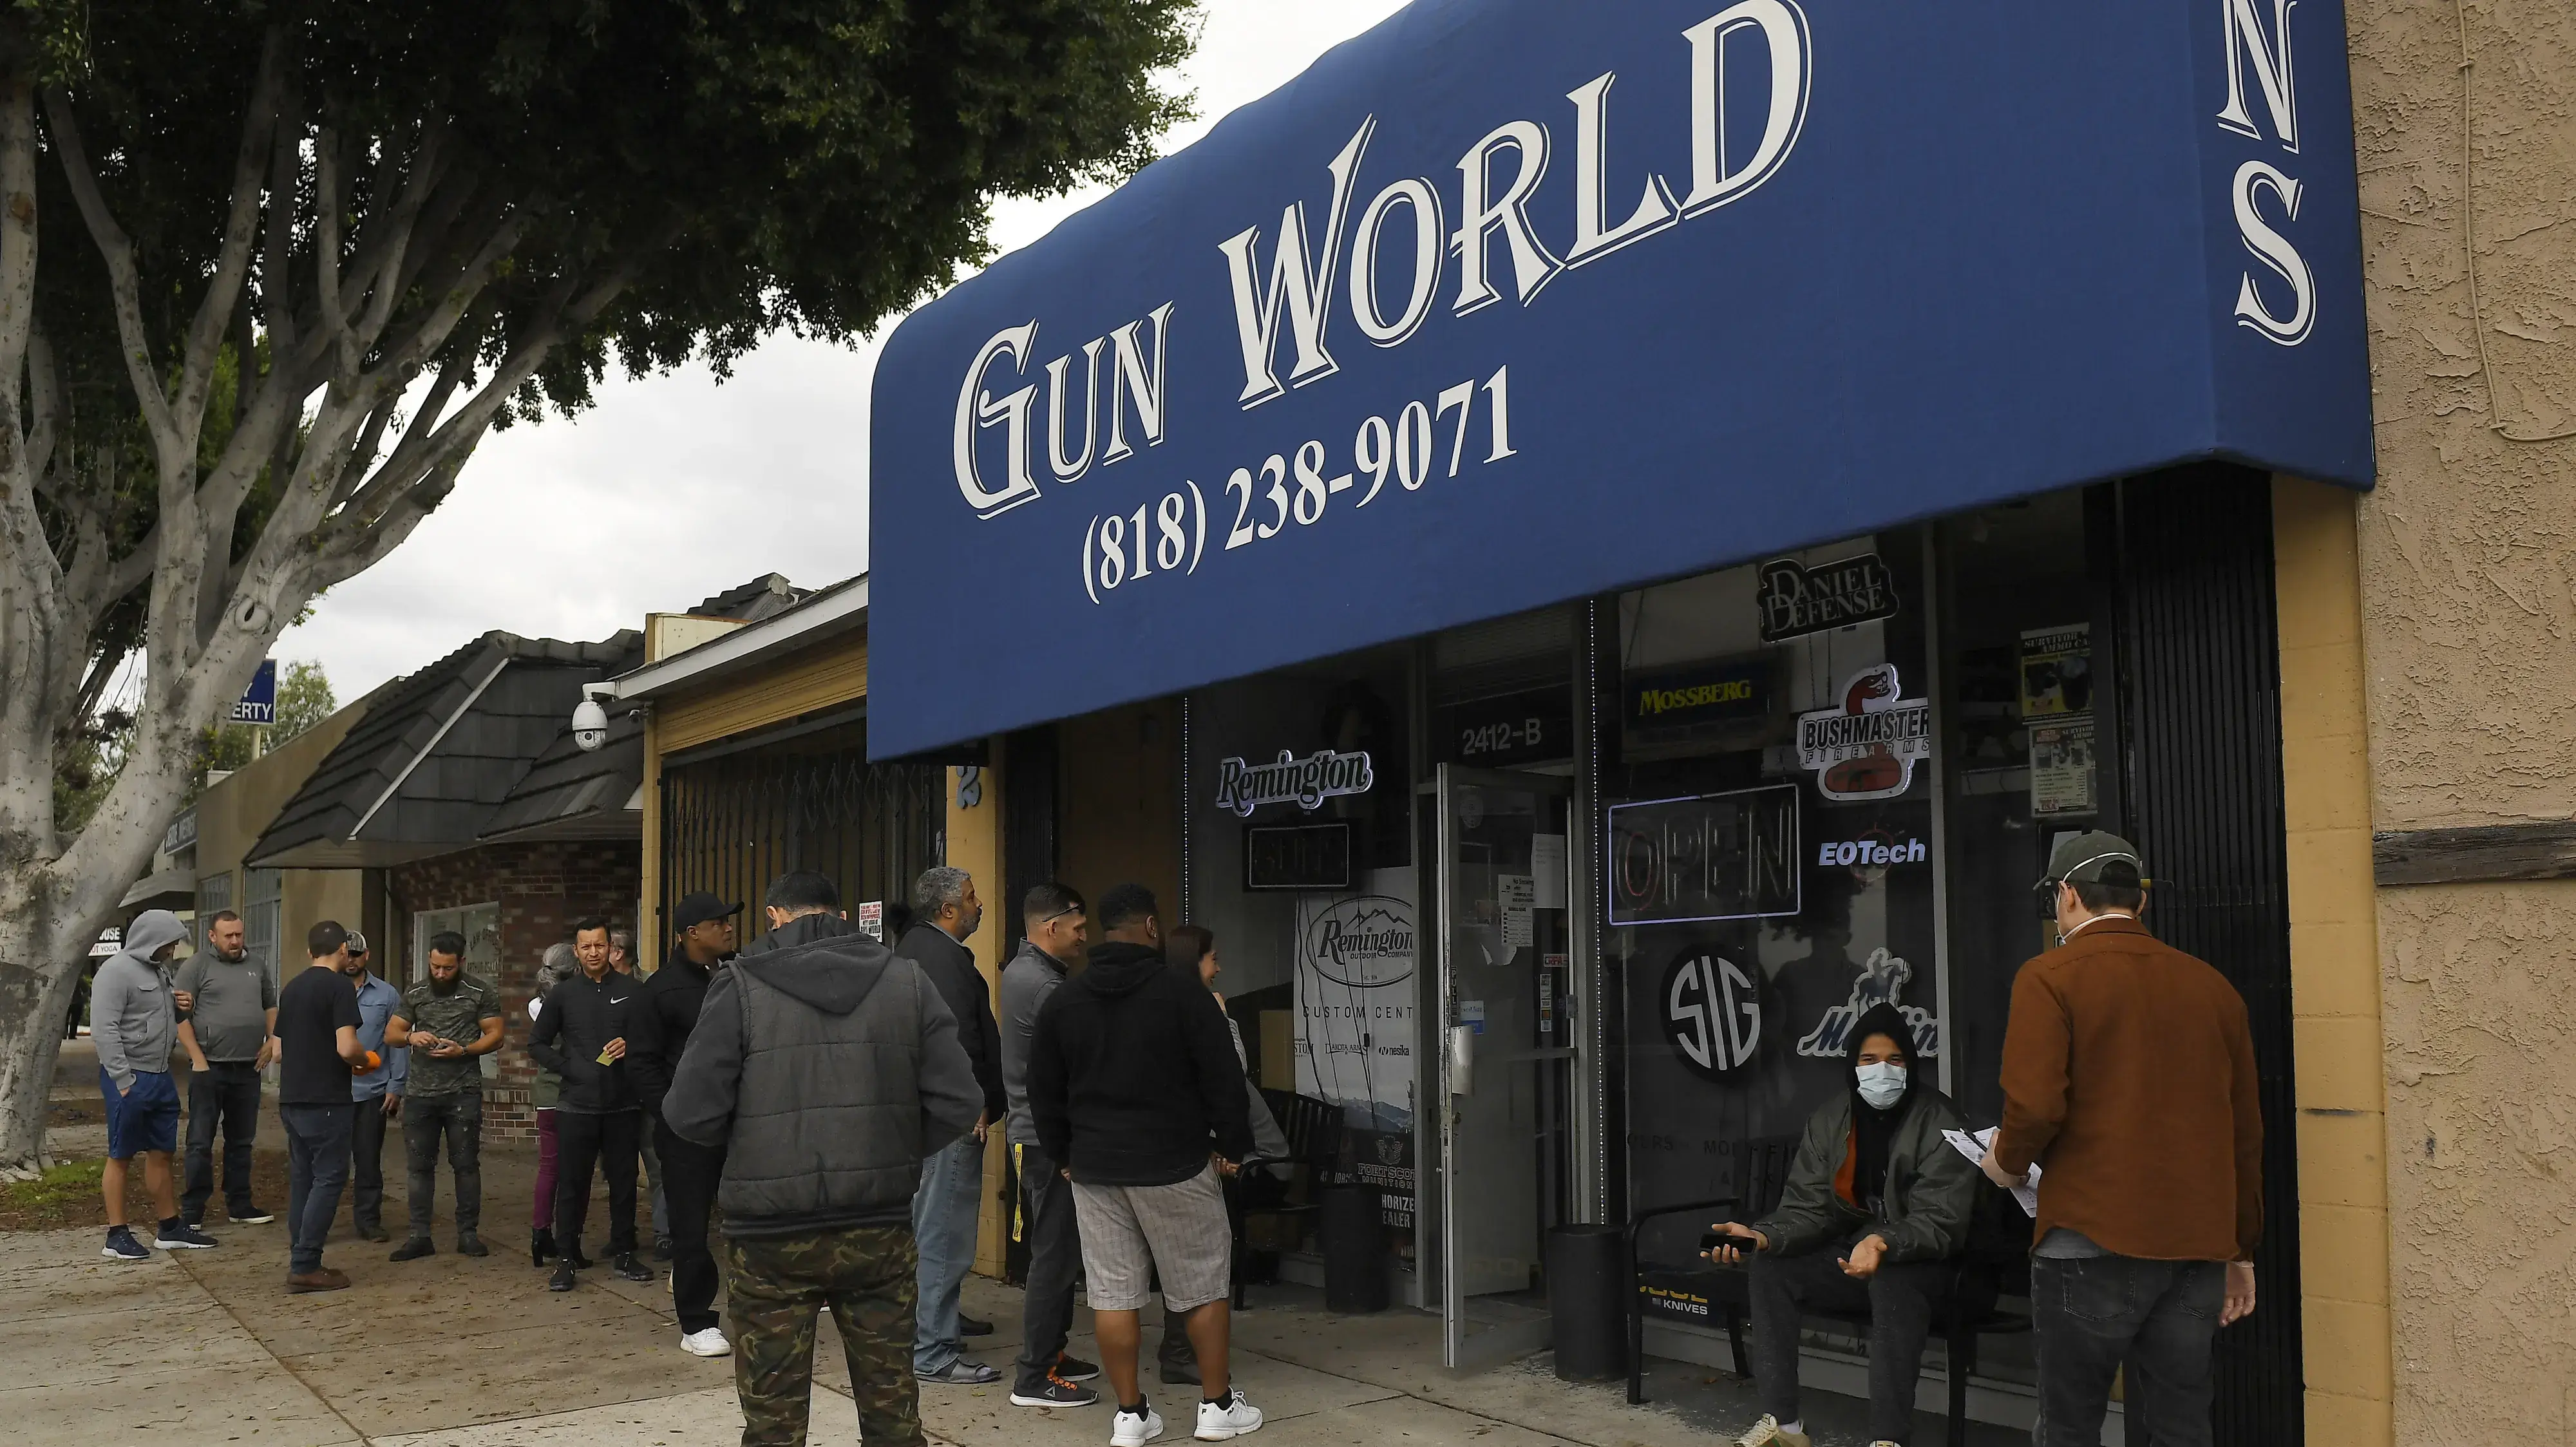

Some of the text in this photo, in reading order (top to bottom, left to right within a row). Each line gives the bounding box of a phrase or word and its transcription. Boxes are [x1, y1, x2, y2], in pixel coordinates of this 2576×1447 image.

[952, 0, 1812, 520] GUN WORLD
[1083, 364, 1517, 605] (818) 238-9071
[1769, 564, 1882, 609] DANIEL
[1765, 587, 1885, 632] DEFENSE
[1638, 679, 1752, 716] MOSSBERG
[1463, 719, 1541, 755] 2412-B
[1804, 706, 1929, 750] BUSHMASTER
[1806, 739, 1929, 764] FIREARMS
[1218, 753, 1368, 813] Remington
[1615, 800, 1795, 911] OPEN
[1819, 838, 1926, 866] EOTech
[1318, 920, 1412, 965] Remington
[1303, 1007, 1365, 1018] CUSTOM
[1671, 956, 1761, 1070] SIG
[1389, 1045, 1410, 1056] nesika
[1358, 1163, 1387, 1177] FORT
[1362, 1175, 1416, 1189] MUNITION
[1663, 1299, 1708, 1315] KNIVES
